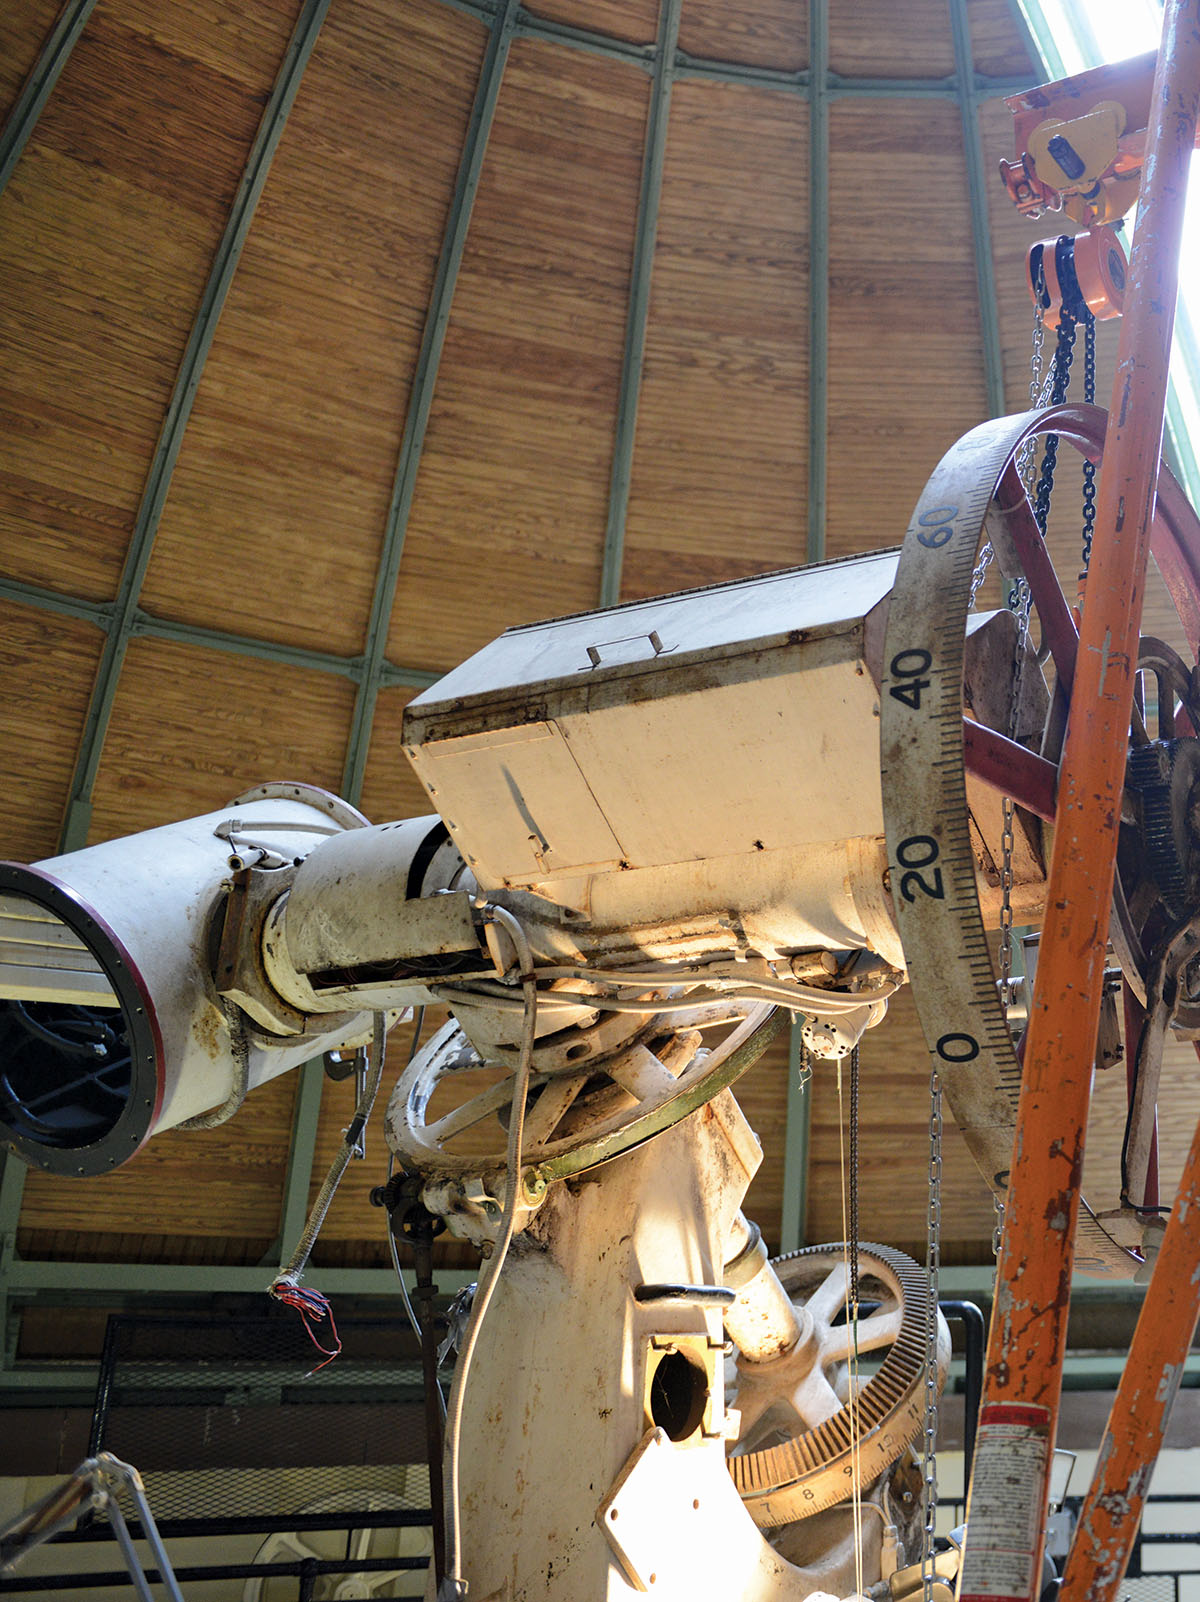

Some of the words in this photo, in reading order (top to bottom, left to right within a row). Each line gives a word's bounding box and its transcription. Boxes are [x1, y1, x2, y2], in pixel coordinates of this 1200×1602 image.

[917, 505, 959, 548] 60
[889, 648, 932, 710] 40
[896, 835, 944, 904] 20
[936, 1033, 980, 1063] 0
[908, 1403, 919, 1419] 11
[843, 1465, 853, 1478] 9
[802, 1488, 814, 1501] 8
[760, 1502, 771, 1514] 7
